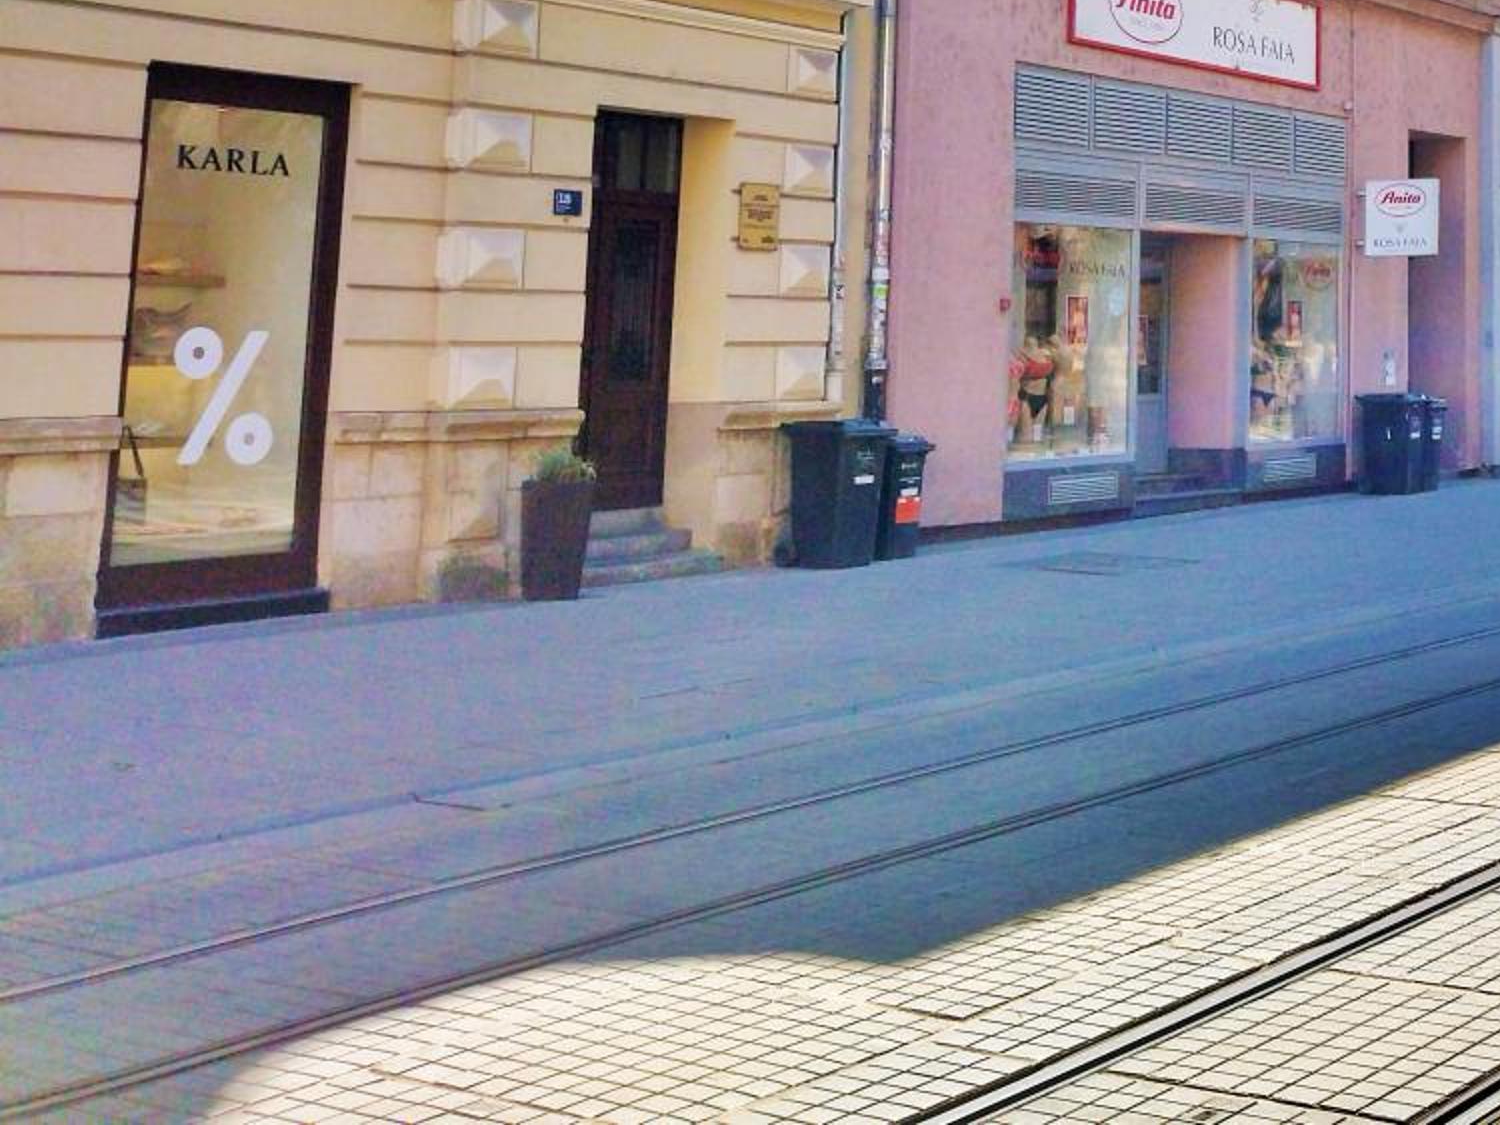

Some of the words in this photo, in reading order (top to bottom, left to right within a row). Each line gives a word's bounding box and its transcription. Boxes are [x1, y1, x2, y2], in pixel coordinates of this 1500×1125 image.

[1212, 25, 1257, 56] ROSA
[1260, 33, 1296, 65] FAIA
[176, 144, 290, 177] KARLA
[1381, 190, 1421, 205] Anita
